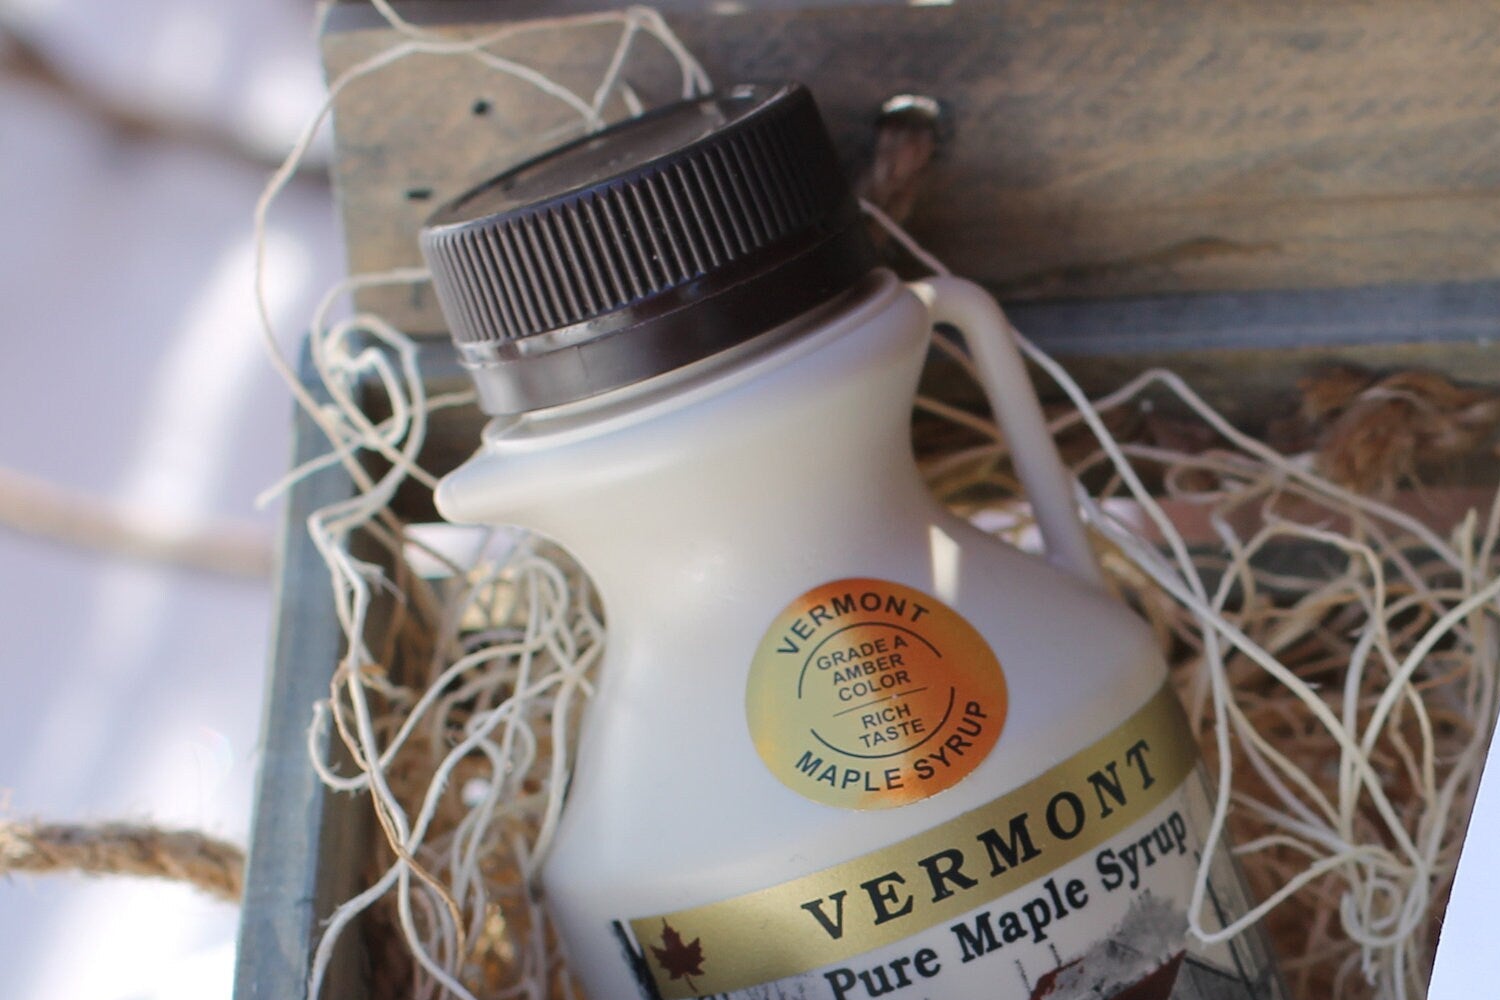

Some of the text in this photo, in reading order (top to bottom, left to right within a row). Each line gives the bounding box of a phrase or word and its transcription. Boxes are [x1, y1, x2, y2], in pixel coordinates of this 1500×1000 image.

[777, 592, 929, 655] VERMONT
[817, 635, 908, 671] GRADE A
[833, 653, 905, 685] AMBER
[839, 670, 911, 701] COLOR
[859, 718, 925, 748] TASTE
[862, 703, 911, 729] RICH
[795, 700, 988, 791] MAPLE SYRUP
[801, 739, 1156, 941] VERMONT
[951, 873, 1089, 964] Maple
[1096, 810, 1188, 892] Syrup
